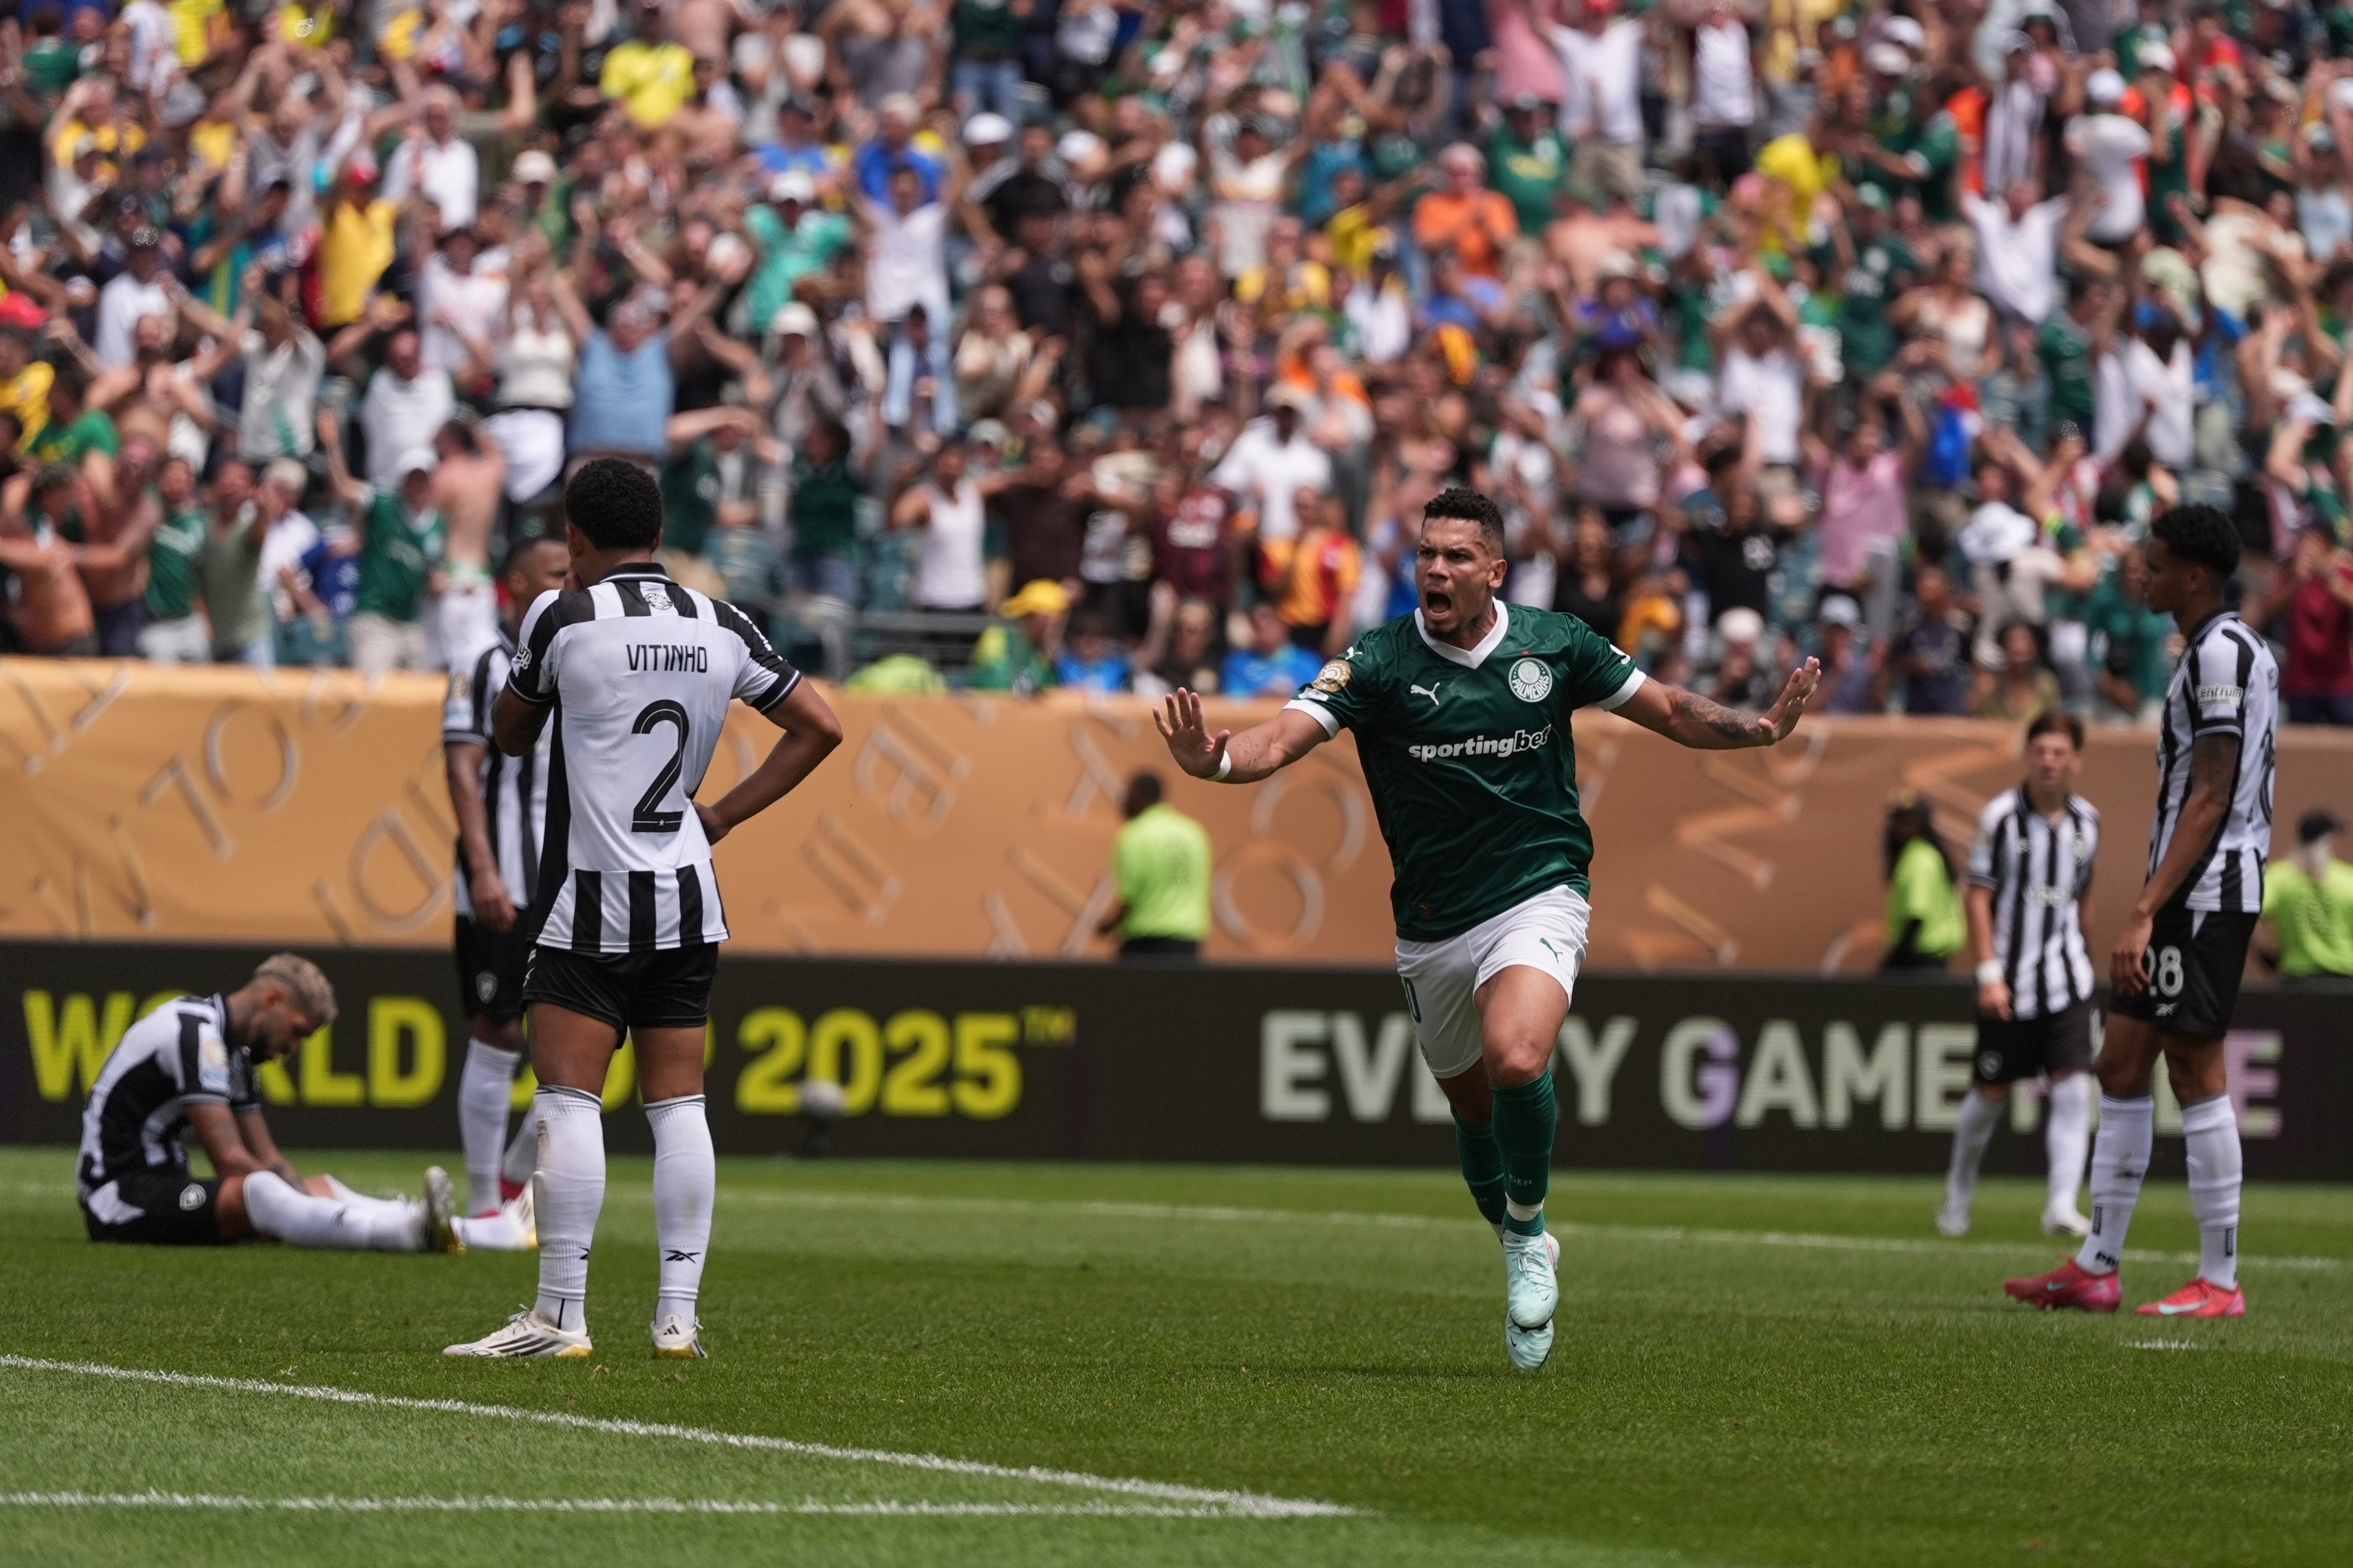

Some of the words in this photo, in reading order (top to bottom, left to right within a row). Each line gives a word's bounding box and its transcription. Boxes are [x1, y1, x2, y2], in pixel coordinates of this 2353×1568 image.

[626, 644, 708, 673] VITINHO
[1512, 675, 1549, 699] PALMEIRAS
[631, 699, 690, 833] 2
[1408, 723, 1551, 763] sportingbet
[22, 988, 446, 1108] WLD
[1660, 1015, 1979, 1131] GAME
